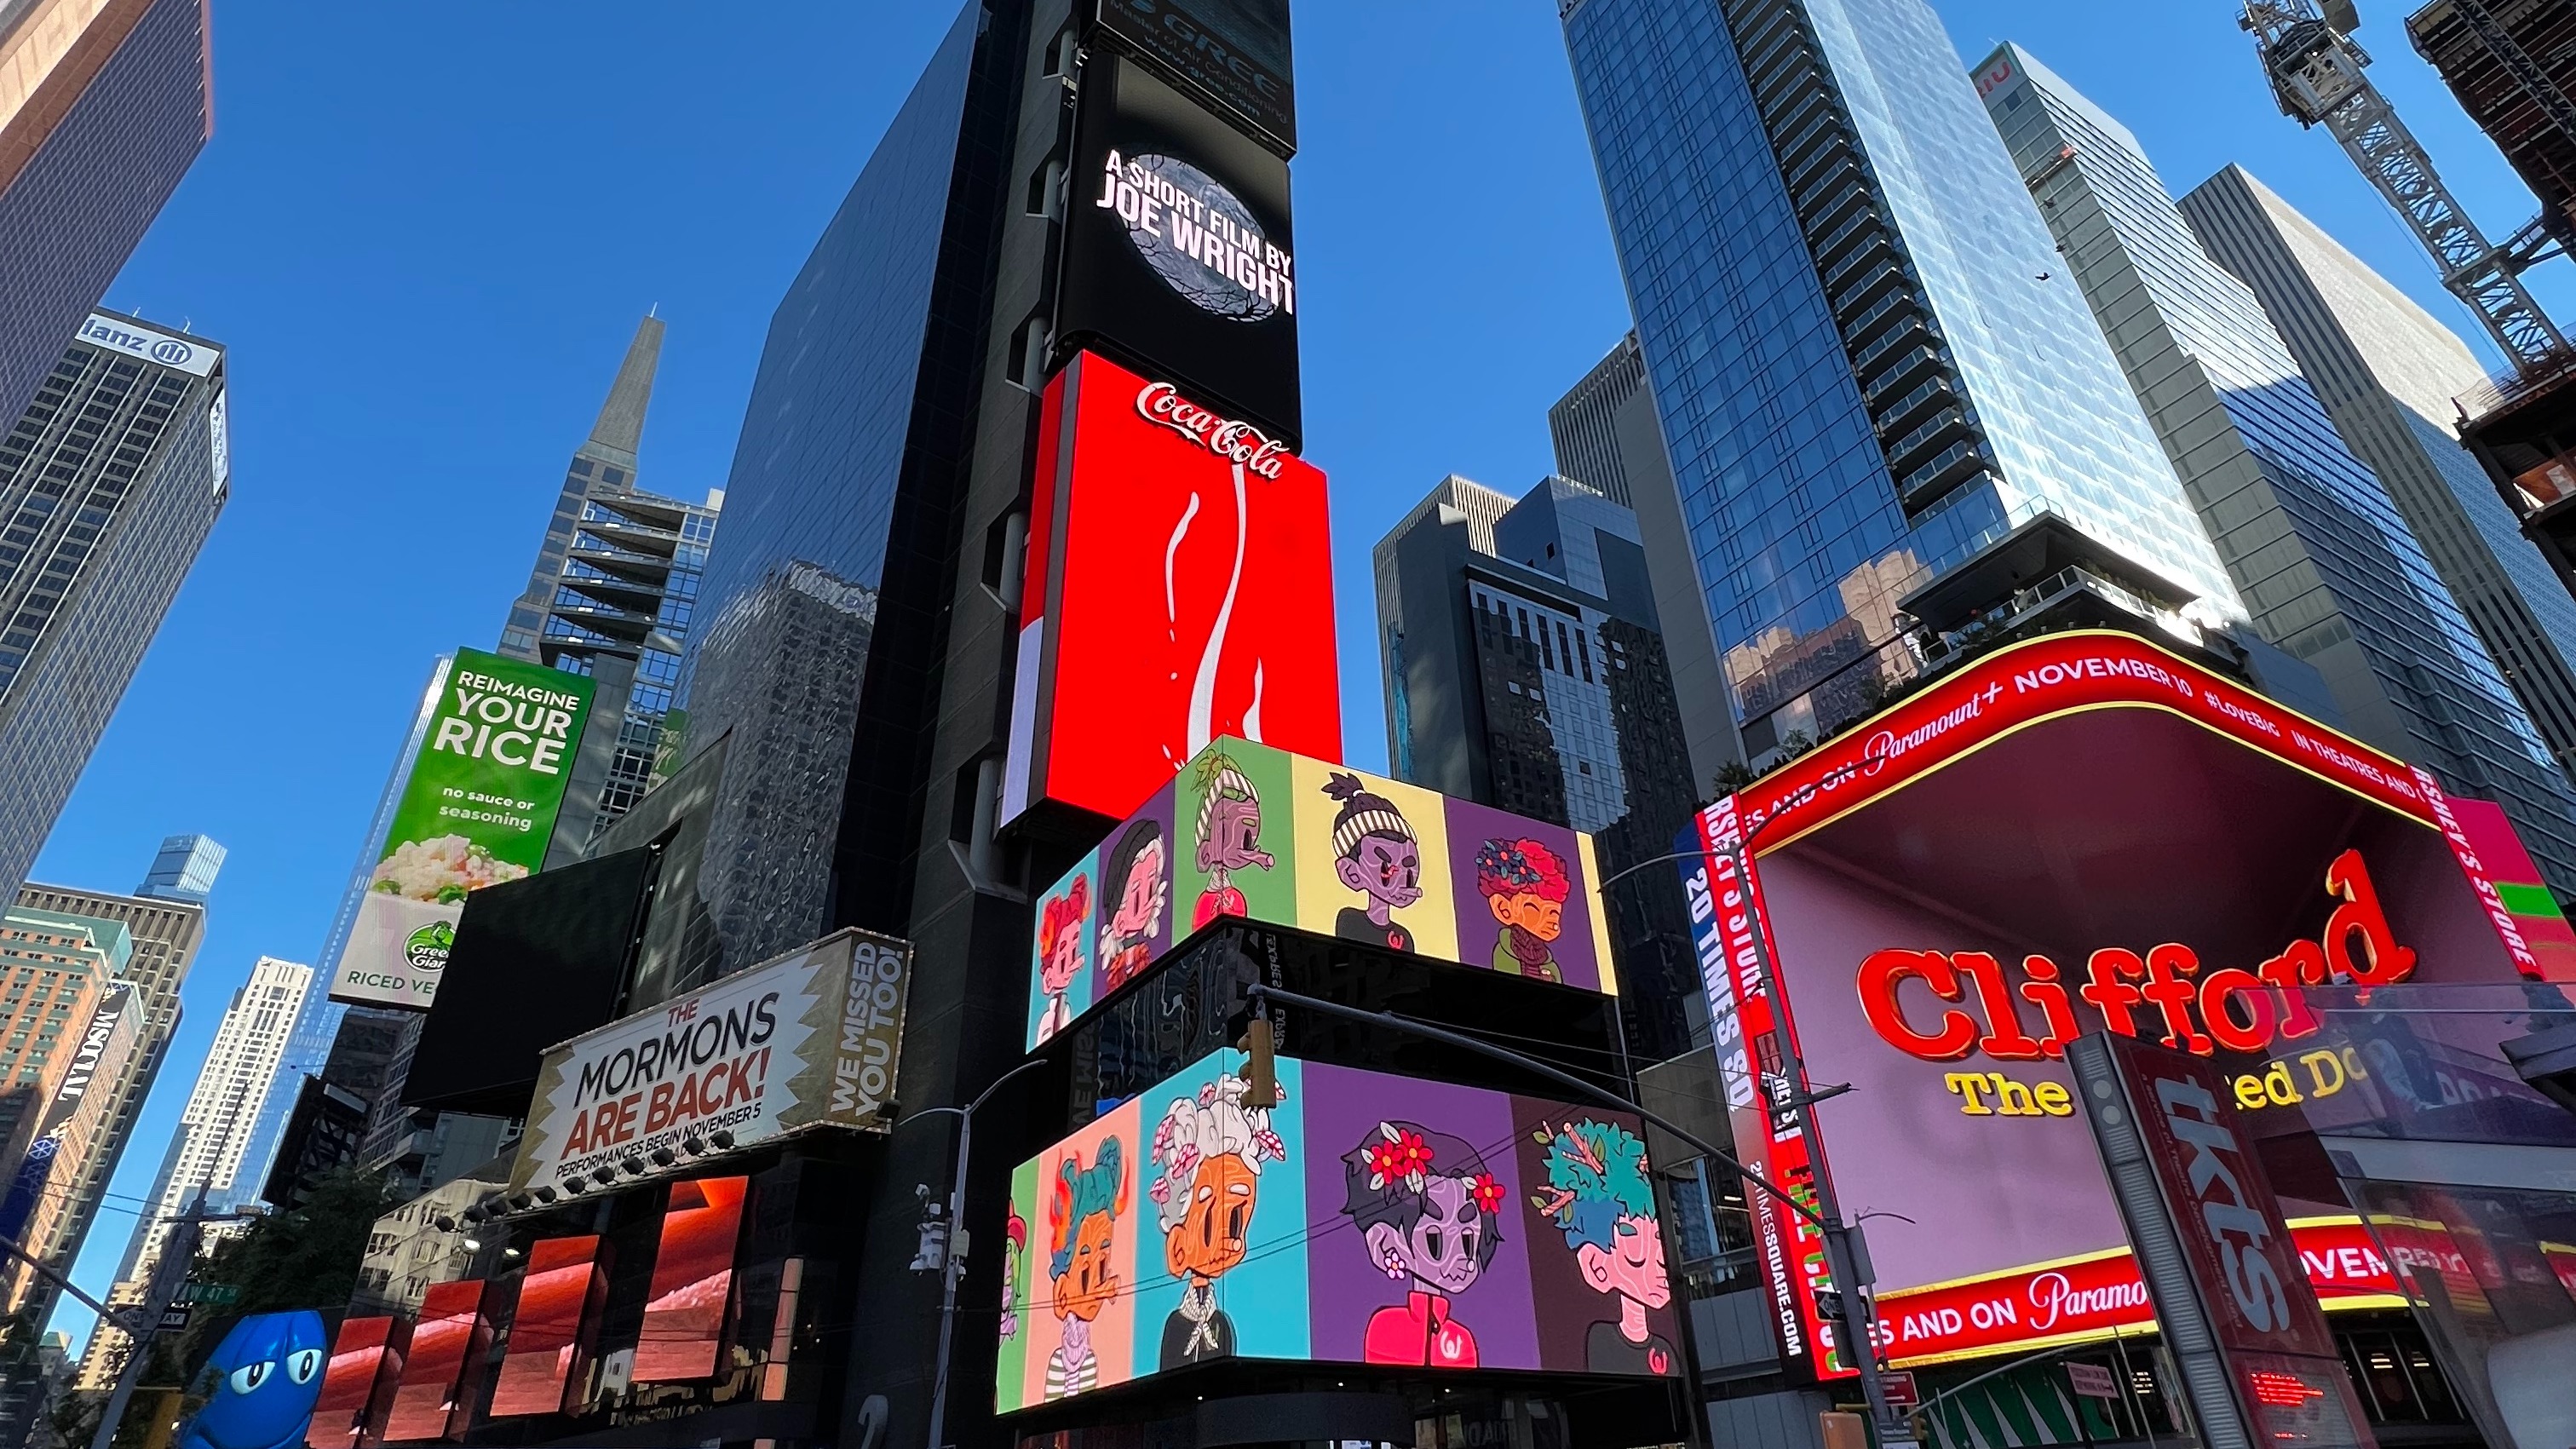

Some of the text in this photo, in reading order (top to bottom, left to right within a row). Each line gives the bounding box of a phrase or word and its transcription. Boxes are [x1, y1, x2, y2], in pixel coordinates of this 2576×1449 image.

[1144, 34, 1261, 118] www.gree.com
[1164, 14, 1279, 101] GREE
[1182, 47, 1201, 63] Air
[1205, 60, 1287, 124] Conditioning
[1096, 174, 1294, 315] JOE WRIGHT
[1106, 150, 1291, 272] A SHORT FILM BY
[455, 687, 572, 739] YOUR
[458, 670, 579, 711] REIMAGINE
[433, 716, 568, 775] RICE
[1771, 781, 1816, 815] AND
[1821, 759, 1857, 791] ON
[1864, 681, 2003, 777] Paramount+
[2013, 657, 2174, 694] NOVEMBER
[2175, 676, 2194, 698] 10
[2204, 691, 2280, 737] #LOVEBIG
[2291, 729, 2311, 751] IN
[2309, 739, 2385, 785] THEATRES
[2385, 773, 2417, 799] AND
[440, 804, 532, 831] seasoning
[443, 787, 535, 810] no sauce or
[1685, 868, 1713, 923] 20
[2474, 875, 2537, 967] STORE
[347, 971, 405, 989] RICED
[1698, 925, 1740, 1046] TIMES
[1856, 848, 2416, 1061] Clifford
[574, 992, 780, 1107] MORMONS
[668, 998, 701, 1026] THE
[831, 941, 878, 1115] WE MISSED
[854, 945, 904, 1116] YOU TOO!
[561, 1094, 641, 1159] ARE
[644, 1046, 772, 1134] BACK!
[1944, 1072, 2073, 1116] The
[2224, 1061, 2303, 1111] ed
[555, 1139, 644, 1179] PERFORMANCES
[647, 1129, 682, 1150] BEGIN
[684, 1105, 751, 1138] NOVEMBER
[752, 1102, 762, 1118] 5
[2147, 1084, 2165, 1130] service
[2171, 1149, 2192, 1197] Theatre
[2189, 1199, 2226, 1291] Development
[2225, 1292, 2242, 1328] Fund
[2155, 1074, 2290, 1332] tkts
[164, 1314, 181, 1324] AY
[207, 1287, 224, 1300] 47
[1903, 1308, 1963, 1341] AND
[1971, 1298, 2017, 1330] ON
